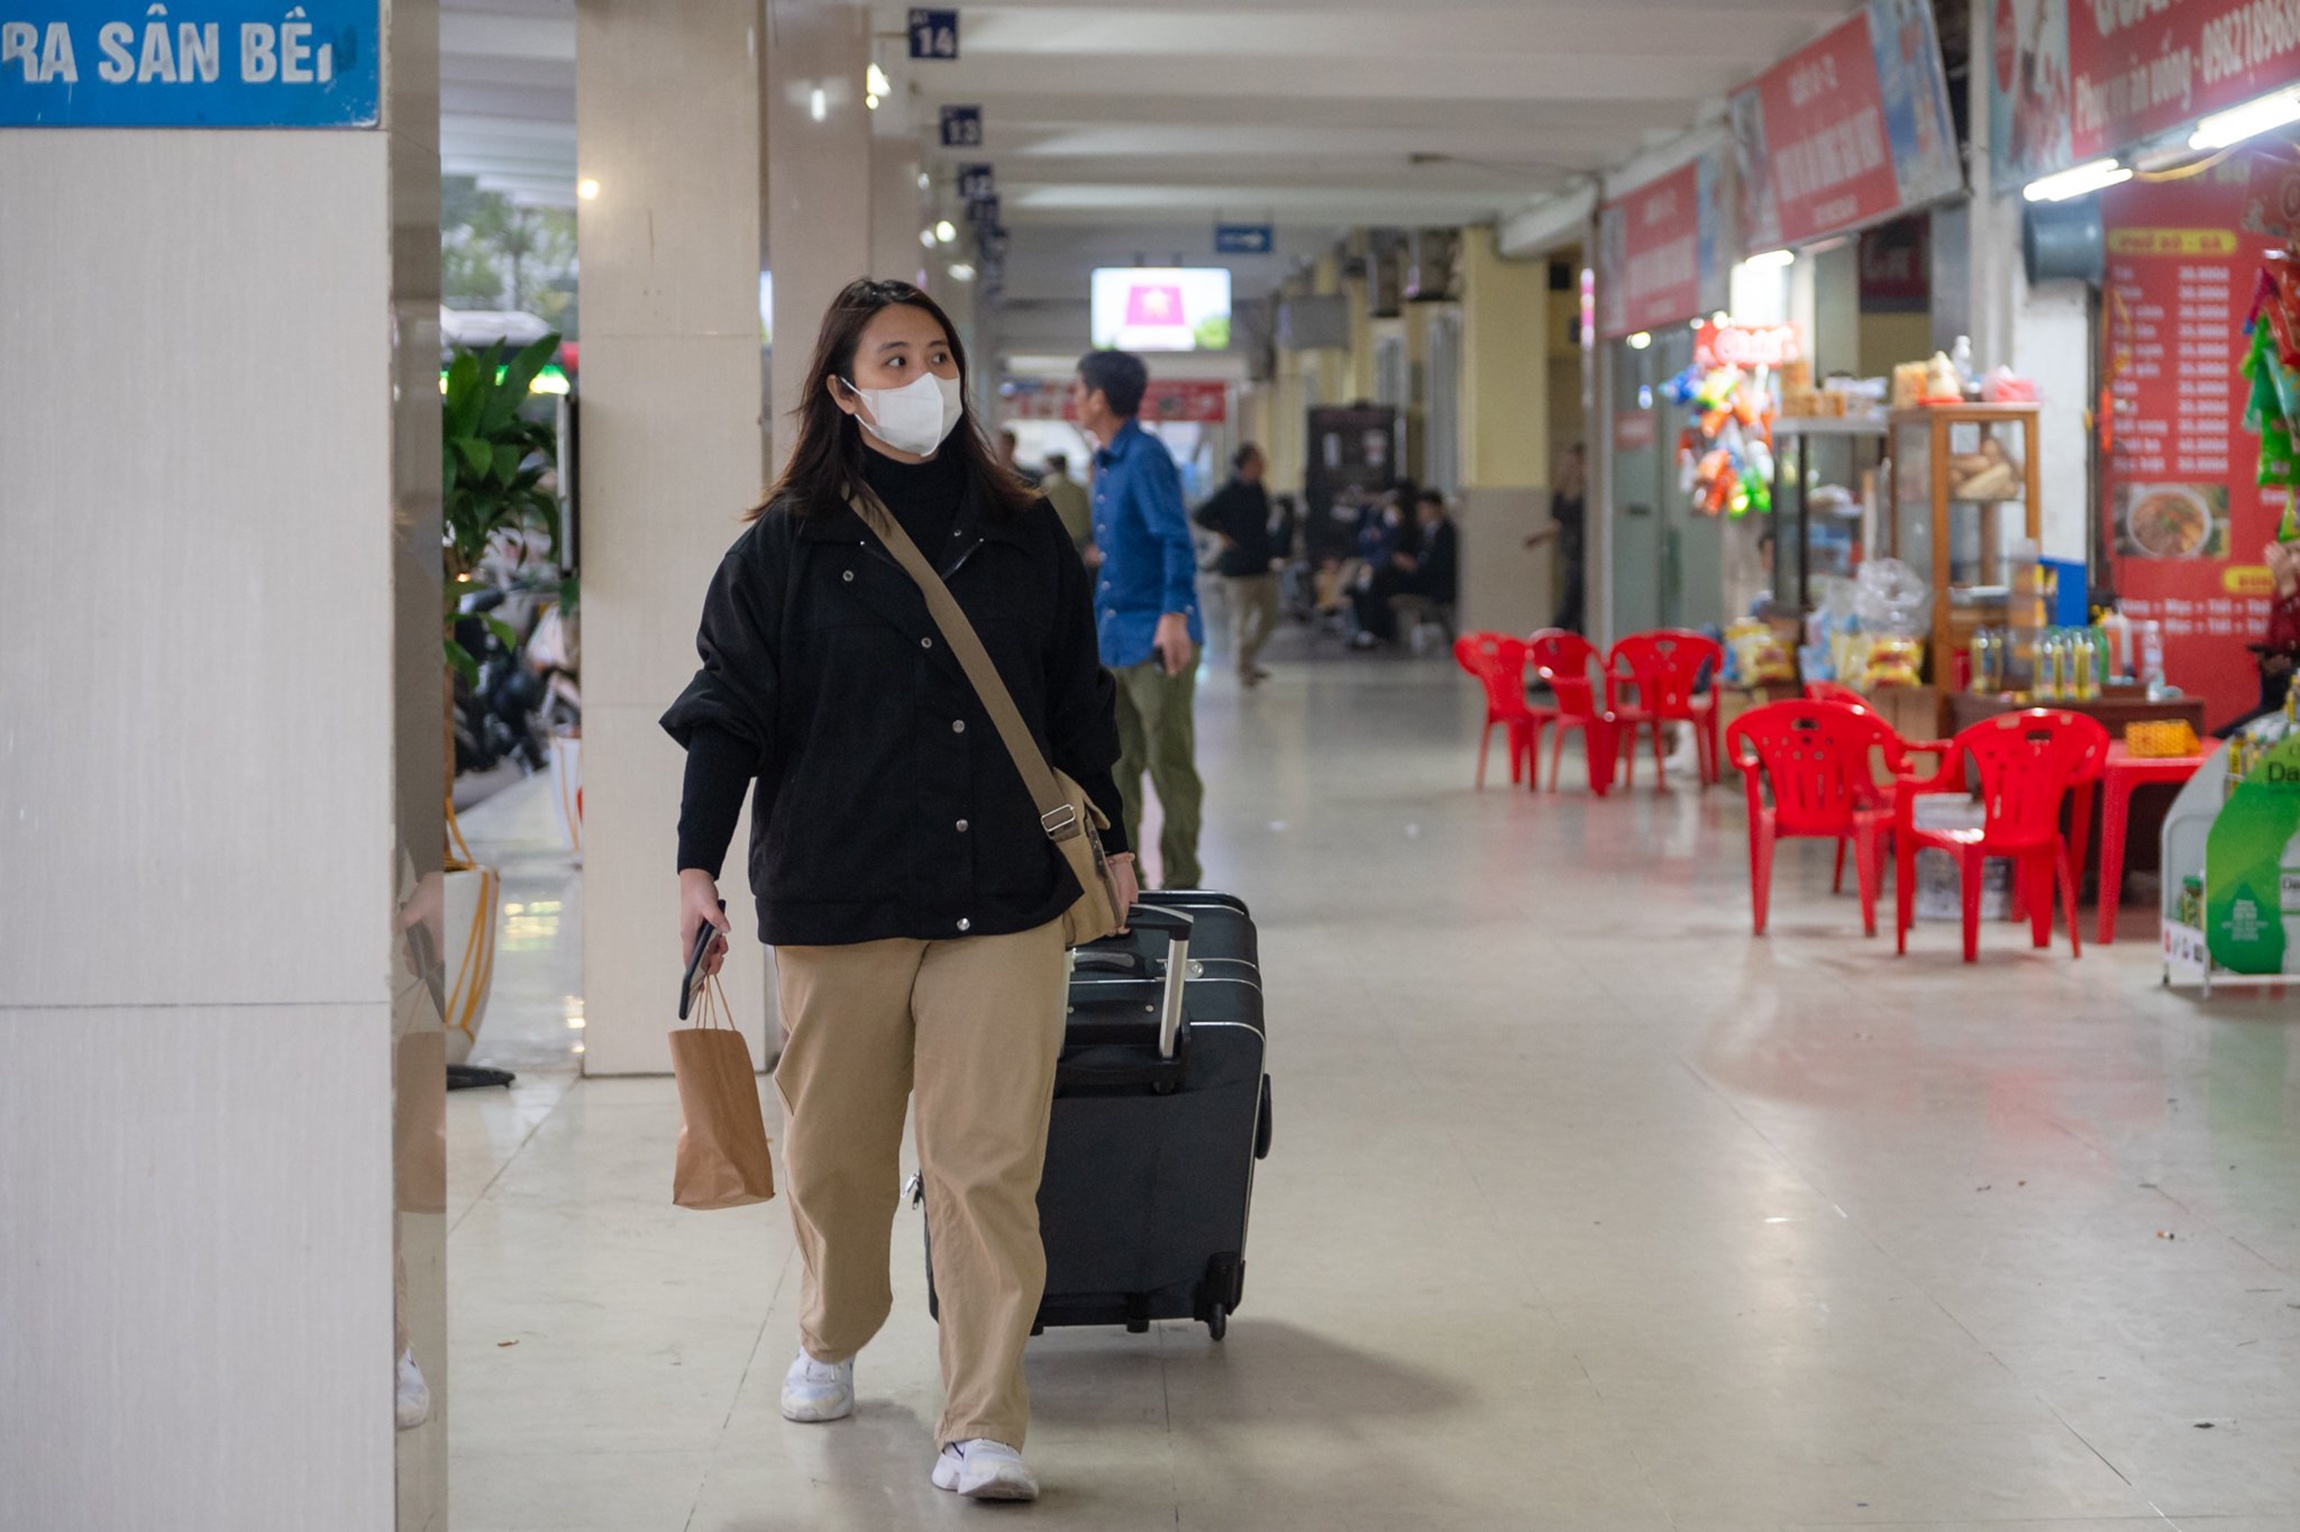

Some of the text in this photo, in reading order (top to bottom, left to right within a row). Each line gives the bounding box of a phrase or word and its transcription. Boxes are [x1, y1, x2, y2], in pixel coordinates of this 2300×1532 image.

[2, 21, 79, 83] RA
[98, 2, 220, 84] SÂN
[918, 26, 953, 56] 14
